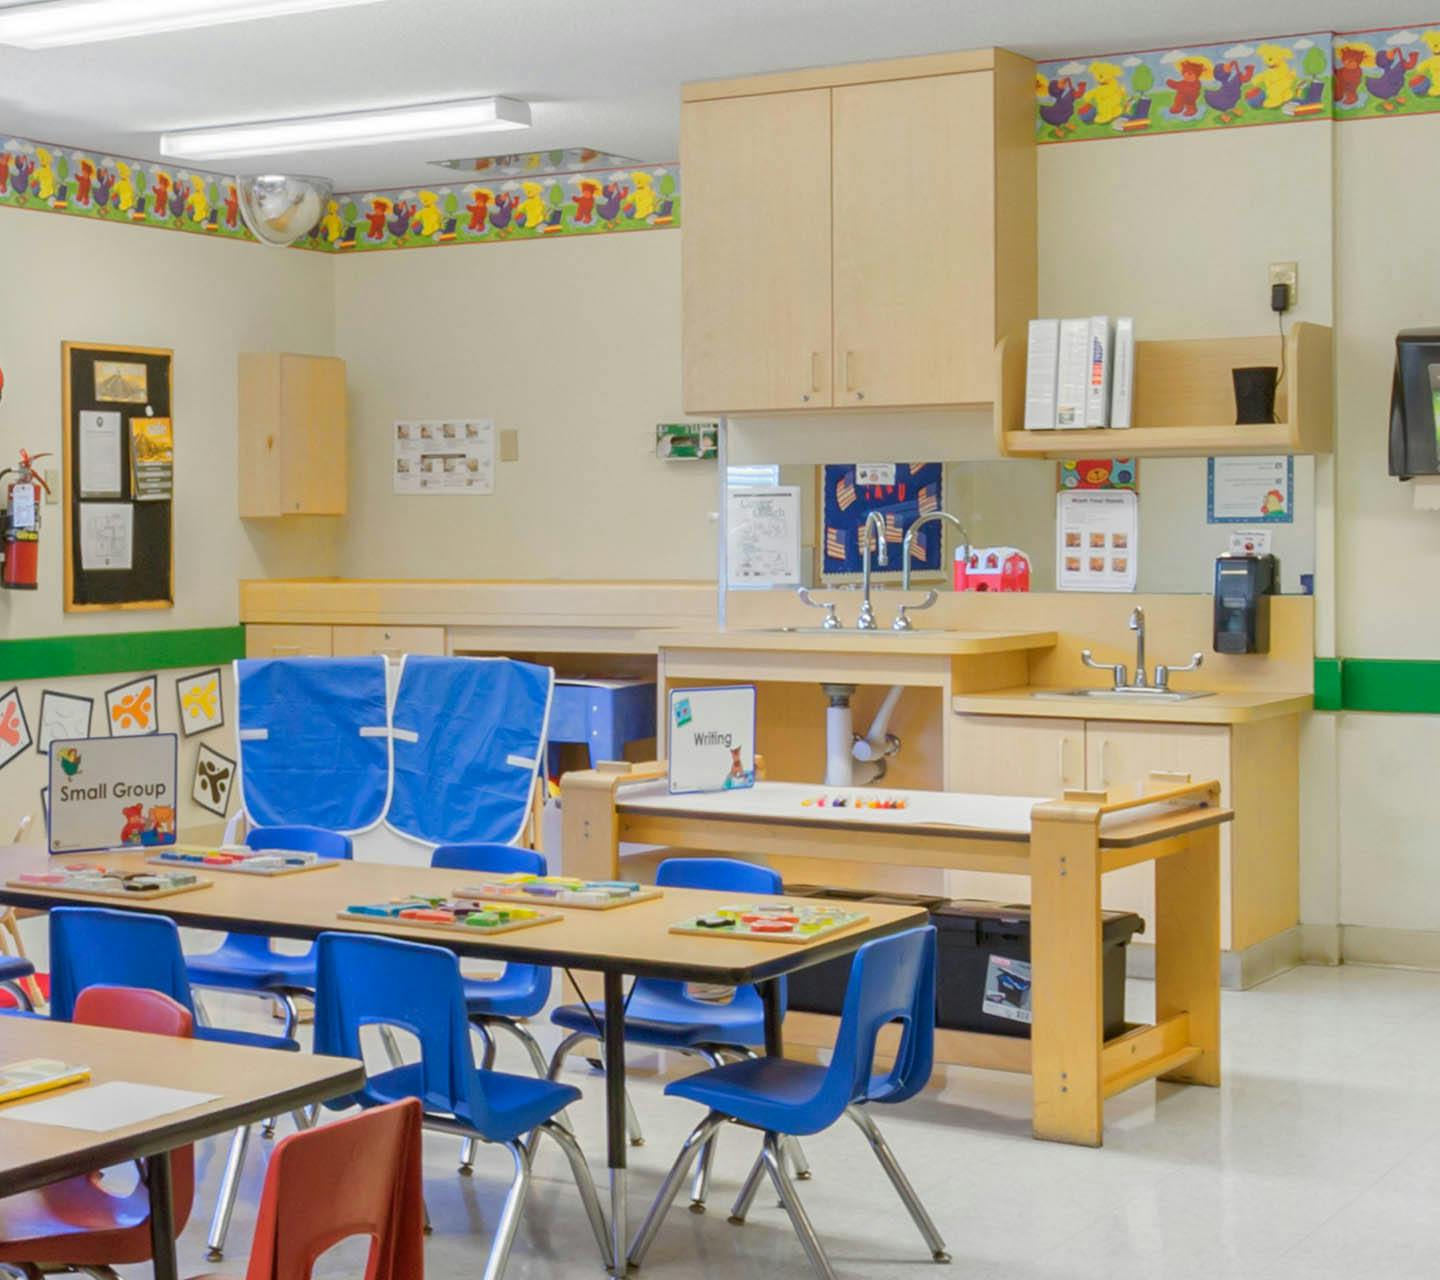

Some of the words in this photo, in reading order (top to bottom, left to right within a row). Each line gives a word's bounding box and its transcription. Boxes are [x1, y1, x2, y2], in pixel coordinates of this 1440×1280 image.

[694, 731, 732, 748] Writing
[60, 783, 108, 802] Small
[112, 781, 167, 800] Group
